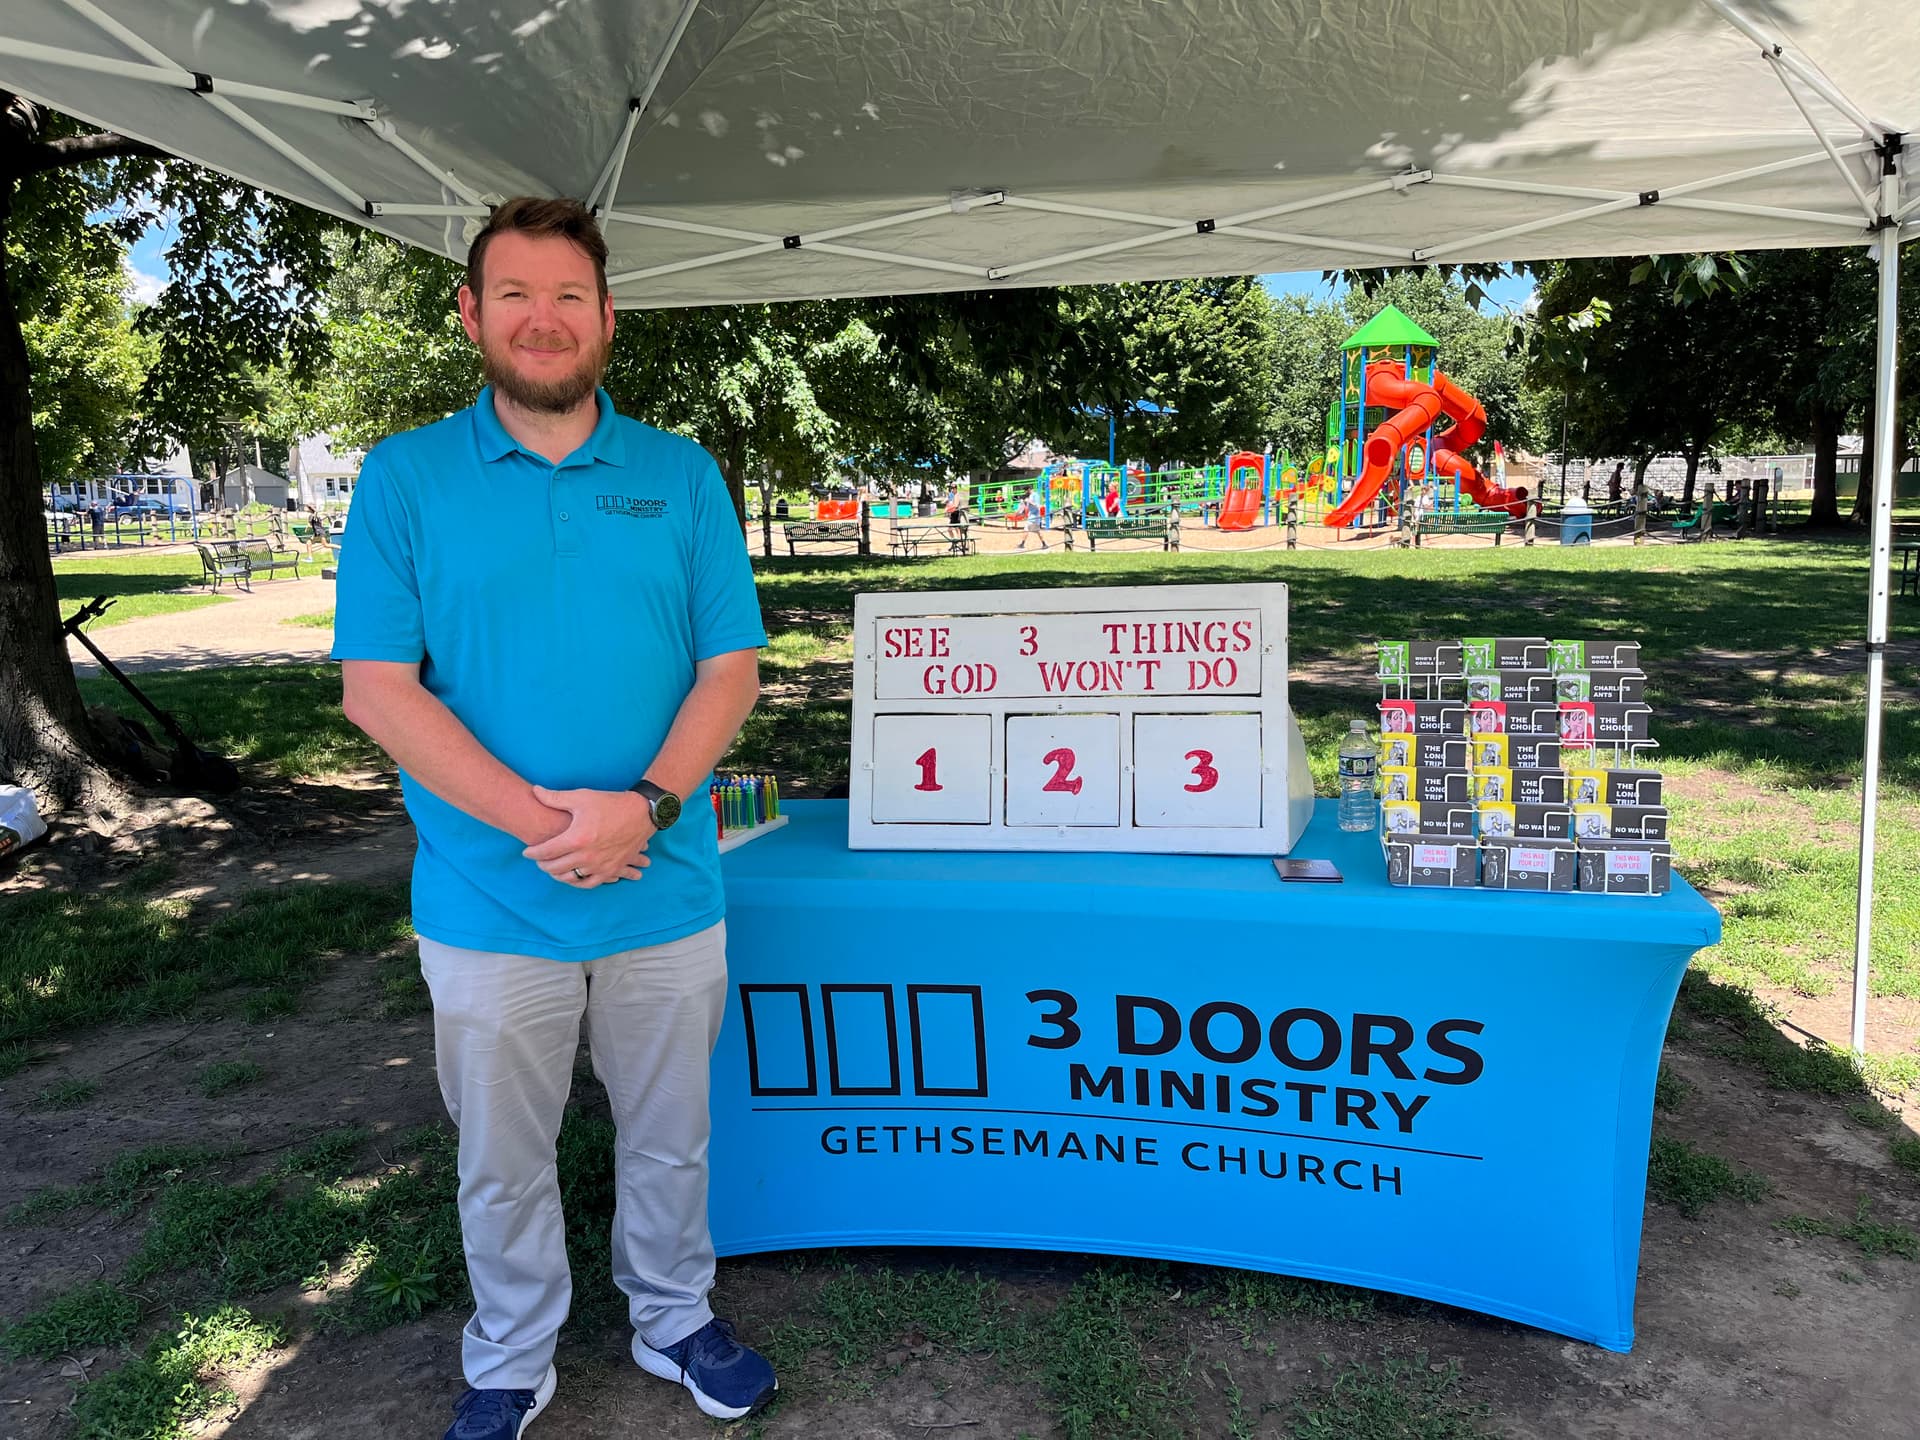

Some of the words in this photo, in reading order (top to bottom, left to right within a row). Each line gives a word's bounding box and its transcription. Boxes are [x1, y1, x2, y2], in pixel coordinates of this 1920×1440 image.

[633, 498, 667, 507] DOORS
[885, 628, 949, 657] SEE
[1019, 626, 1039, 656] 3
[1103, 621, 1252, 654] THINGS
[924, 663, 997, 694] GOD
[1039, 660, 1161, 692] WON'T
[1189, 657, 1238, 691] DO
[914, 747, 943, 792] 1
[1042, 747, 1083, 795] 2
[1183, 749, 1219, 793] 3
[1616, 782, 1634, 790] THE
[1425, 793, 1444, 801] TRIP
[1025, 989, 1081, 1050] 3
[1115, 994, 1485, 1086] DOORS
[1069, 1063, 1431, 1134] MINISTRY
[821, 1125, 1159, 1166] GETHSEMANE
[1181, 1142, 1402, 1196] CHURCH
